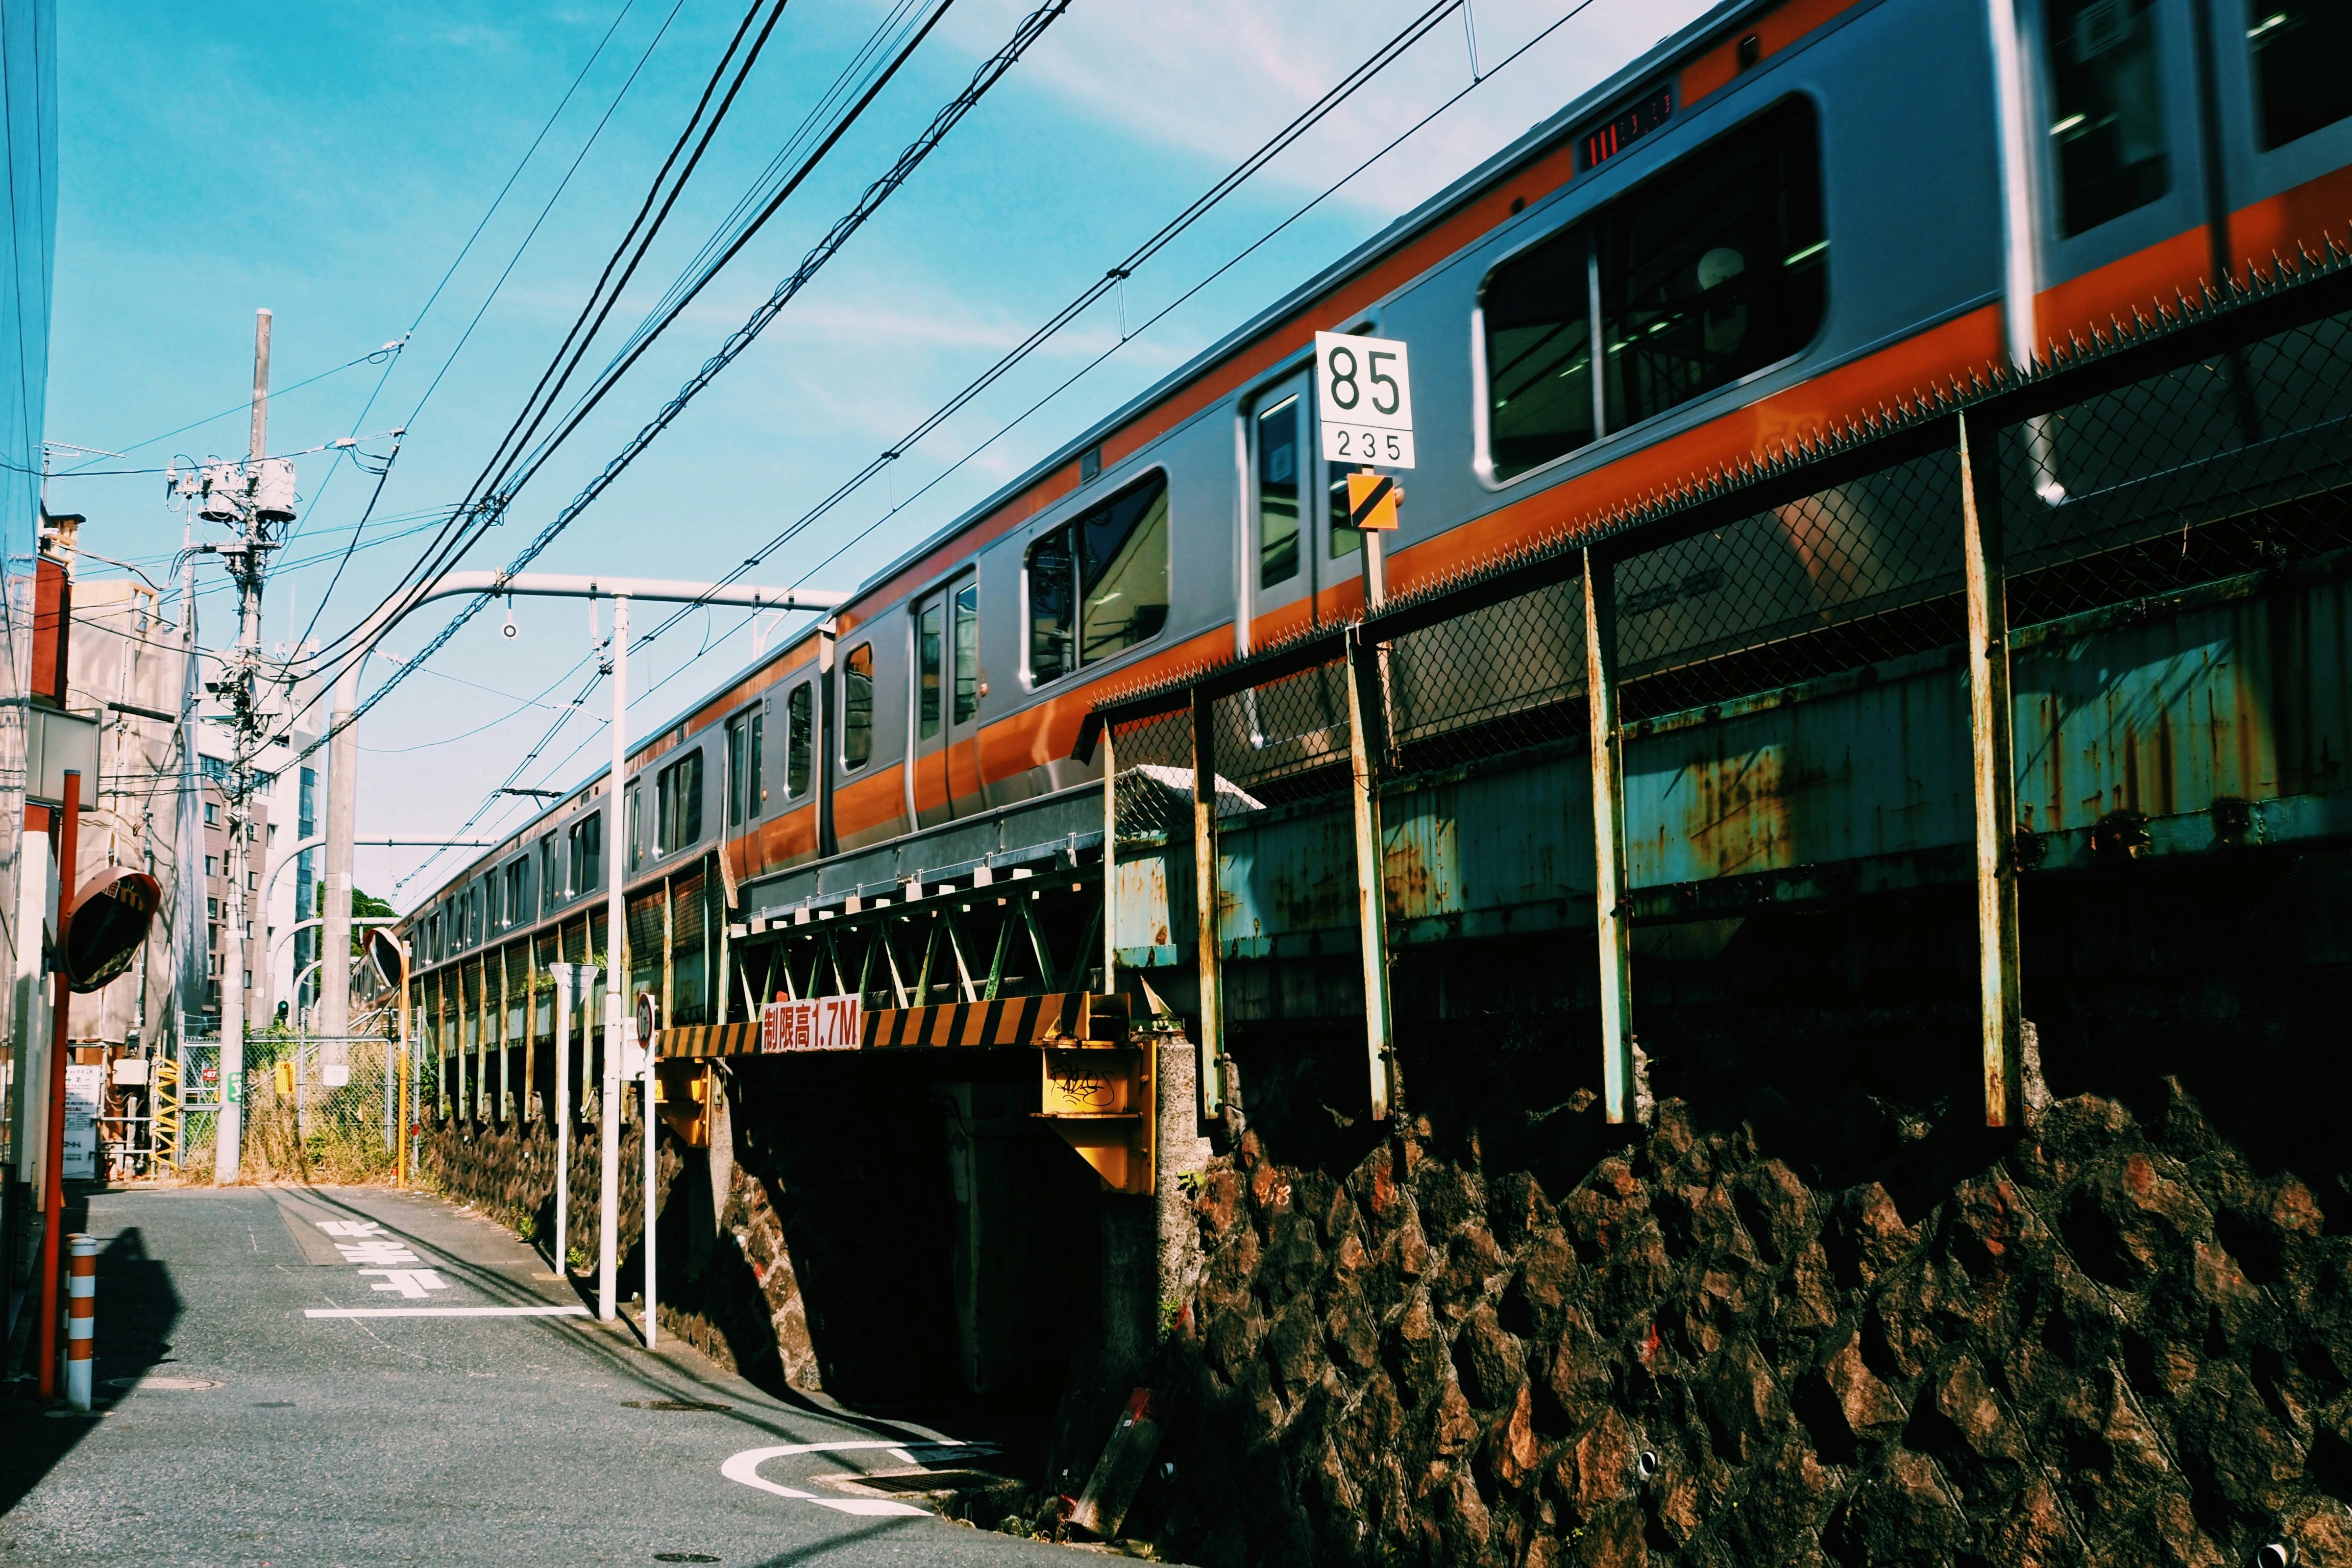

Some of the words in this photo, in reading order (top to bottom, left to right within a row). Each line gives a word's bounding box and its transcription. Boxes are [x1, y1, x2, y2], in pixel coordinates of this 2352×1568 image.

[1329, 346, 1399, 415] 85
[1338, 431, 1400, 460] 235
[763, 1000, 857, 1050] 制限高1.7M
[315, 1220, 448, 1298] 止まれ
